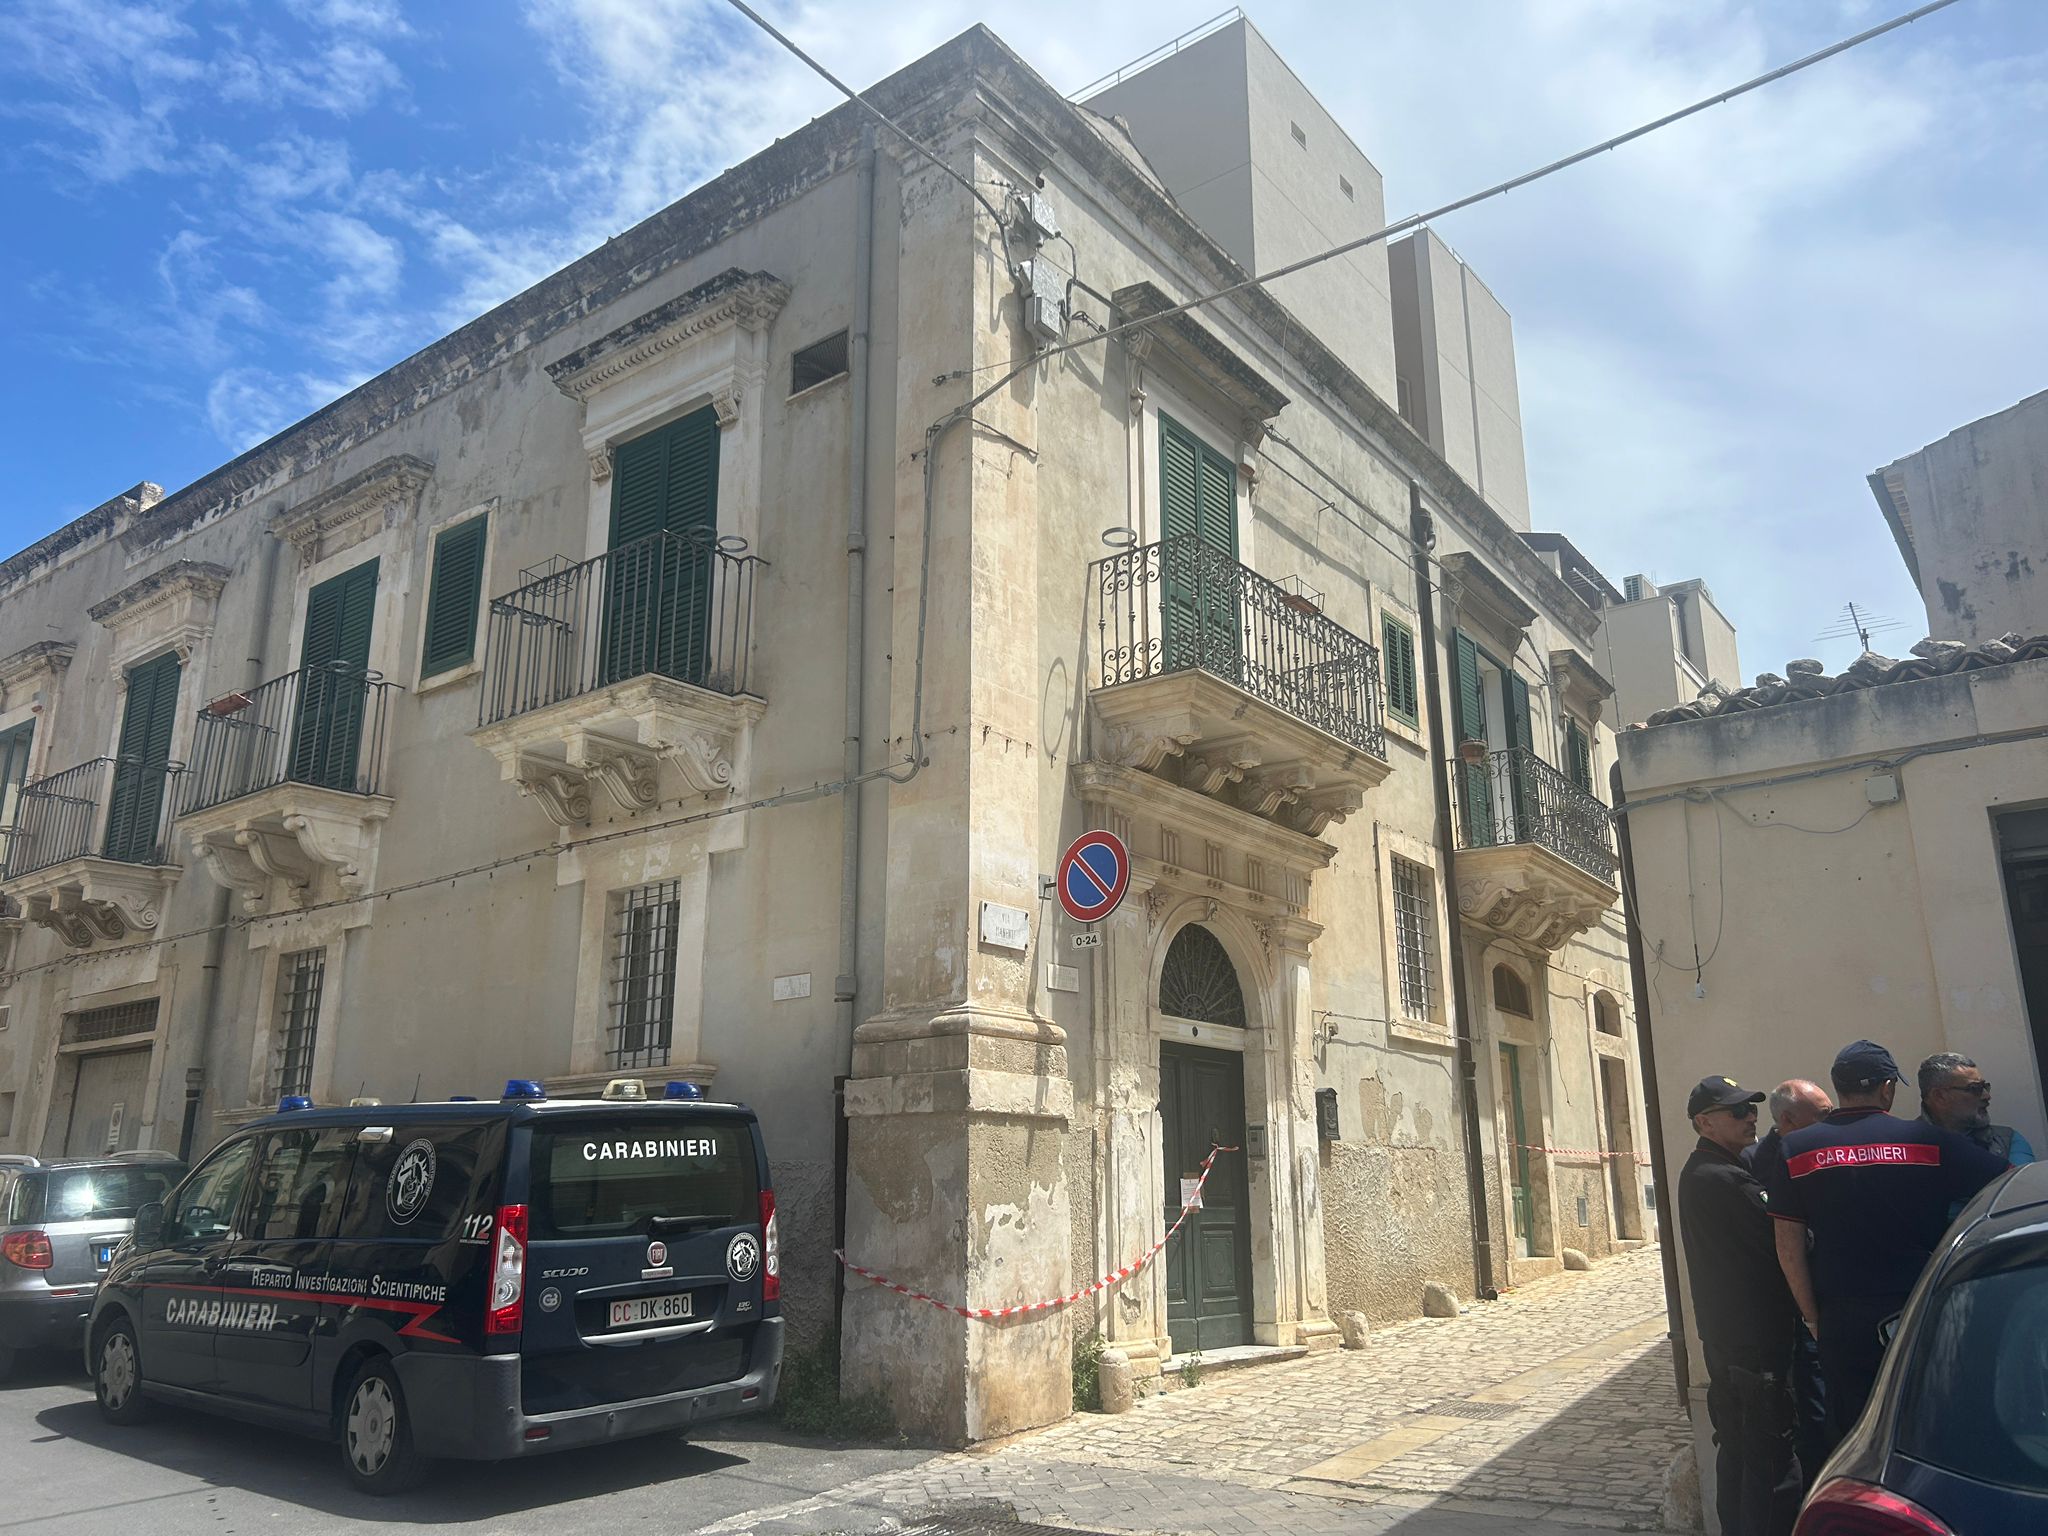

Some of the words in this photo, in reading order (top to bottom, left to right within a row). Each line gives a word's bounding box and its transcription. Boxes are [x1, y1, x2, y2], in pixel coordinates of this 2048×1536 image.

[1076, 934, 1098, 946] 0-24
[583, 1139, 717, 1160] CARABINIERI
[1816, 1146, 1907, 1165] CARABINIERI
[462, 1213, 494, 1239] 112
[541, 1266, 589, 1279] SCUDO
[251, 1267, 292, 1289] REPARTO
[294, 1269, 368, 1294] INVESTIGAZIONI
[370, 1274, 447, 1302] SCIENTIFICHE
[166, 1297, 278, 1332] CARABINIERI
[613, 1302, 632, 1323] CC
[640, 1299, 658, 1320] DK
[663, 1296, 690, 1316] 860
